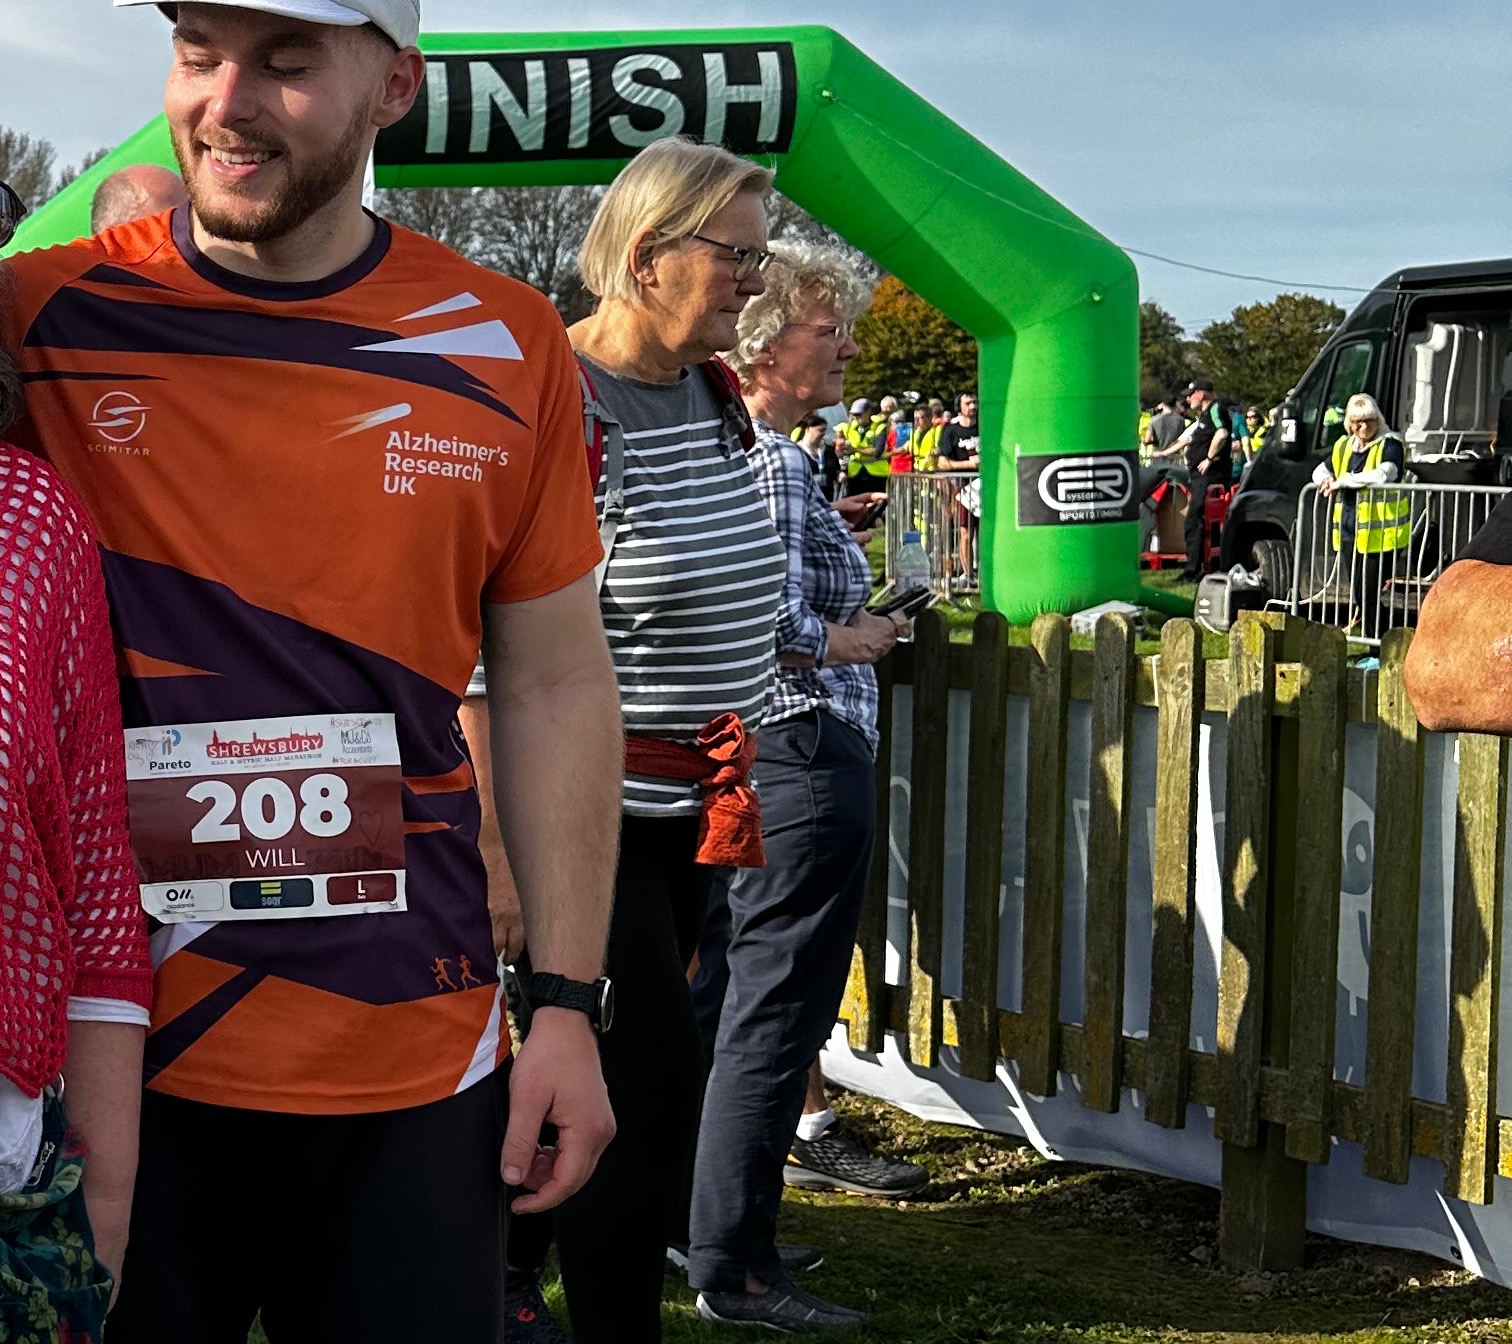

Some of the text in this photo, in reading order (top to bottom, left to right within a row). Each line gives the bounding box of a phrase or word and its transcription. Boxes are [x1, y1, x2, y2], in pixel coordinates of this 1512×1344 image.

[425, 50, 782, 154] INISH
[88, 444, 150, 456] SCIMITAR
[385, 430, 509, 466] Alzheimer's
[384, 452, 483, 483] Research
[383, 474, 416, 496] UK
[209, 738, 321, 758] SHREWSBURY
[149, 759, 192, 771] Pareto
[185, 773, 352, 844] 208
[245, 847, 306, 869] WILL
